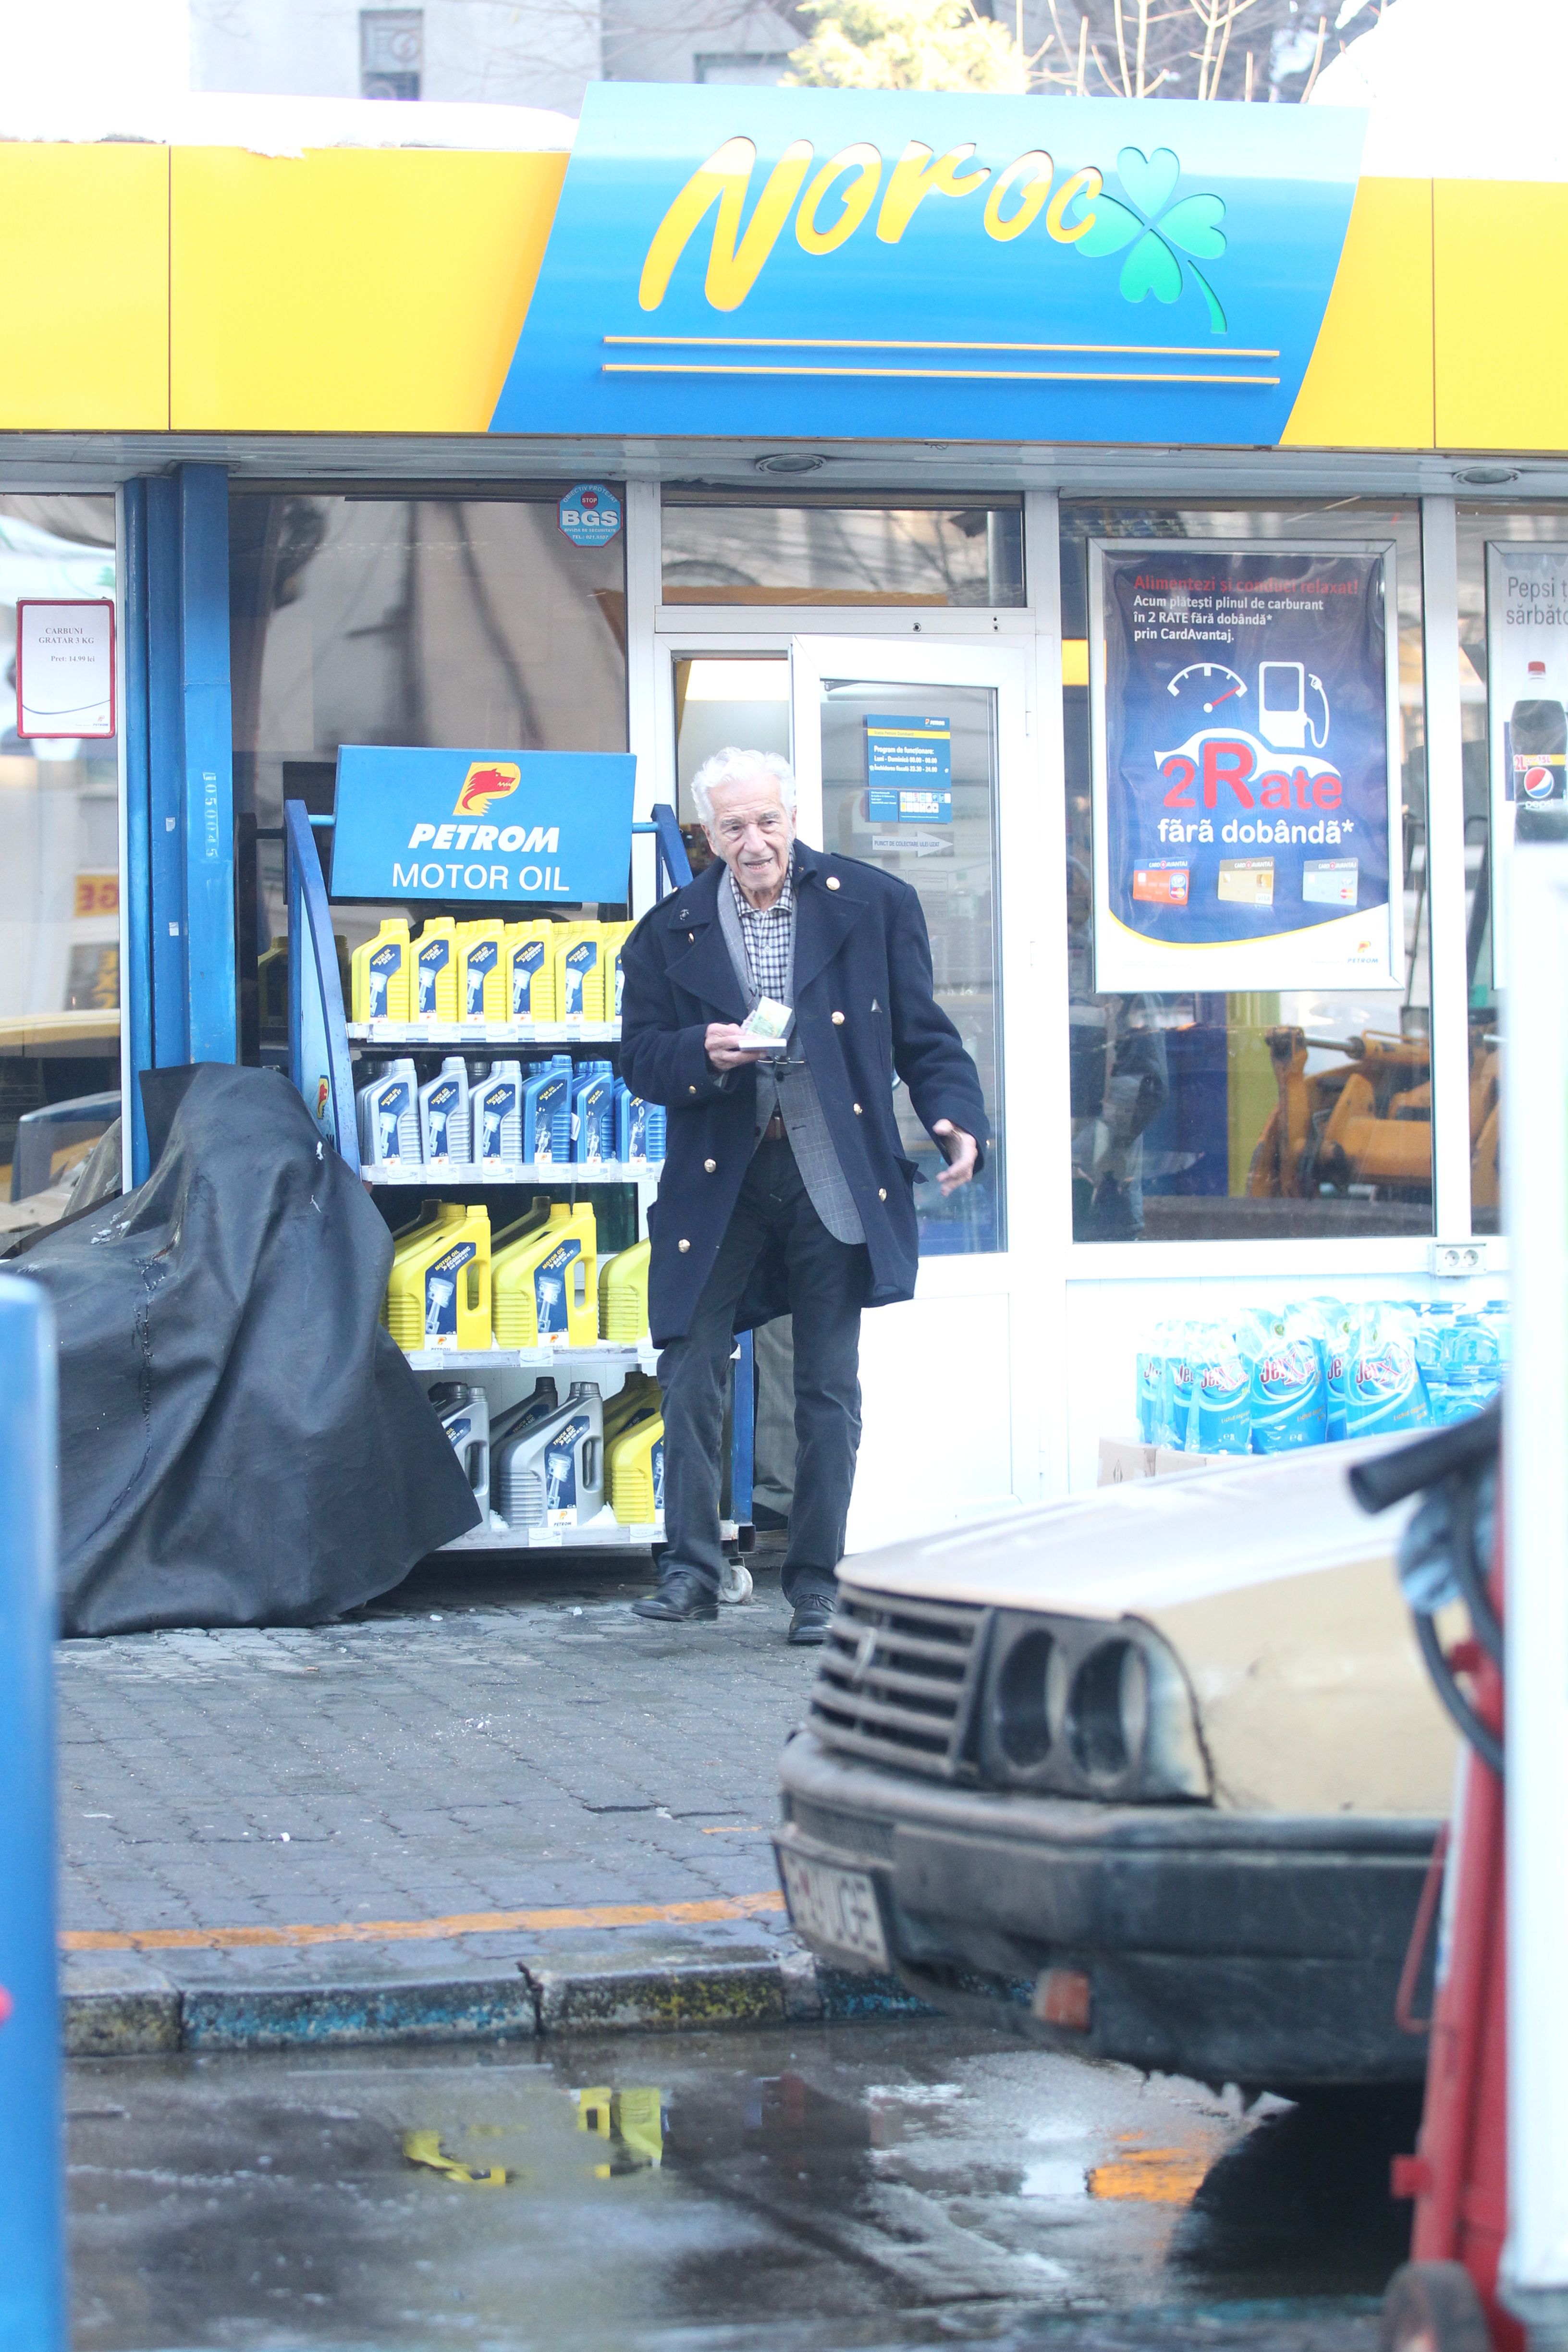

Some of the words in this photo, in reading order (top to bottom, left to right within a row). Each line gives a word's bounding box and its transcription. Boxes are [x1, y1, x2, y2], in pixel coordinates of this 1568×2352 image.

[638, 136, 1103, 312] Noroc
[563, 486, 588, 503] OBIECTIV
[589, 485, 618, 503] PROTEJAT
[562, 510, 619, 527] BGS
[1134, 575, 1215, 591] Alimentezi
[1236, 578, 1296, 593] conduci
[1300, 579, 1359, 594] relaxat!
[1508, 576, 1555, 602] Pepsi
[1133, 595, 1166, 607] Acum
[1215, 597, 1248, 610] plinul
[1250, 598, 1264, 609] de
[1268, 598, 1323, 611] carburant
[1134, 612, 1145, 623] în
[1148, 612, 1156, 623] 2
[1159, 612, 1188, 624] RATE
[1190, 612, 1214, 624] fără
[1134, 628, 1157, 643] prin
[1160, 628, 1234, 643] CardAvantaj.
[874, 745, 896, 754] Program
[407, 823, 560, 853] PETROM
[392, 862, 509, 890] MOTOR
[519, 866, 570, 891] OIL
[372, 954, 385, 966] MOTOR
[380, 953, 391, 963] PLUS
[421, 949, 434, 961] MOTOR
[429, 948, 439, 959] PLUS
[469, 951, 482, 963] MOTOR
[515, 951, 528, 963] MOTOR
[568, 951, 580, 962] MOTOR
[380, 1093, 393, 1106] MOTOR
[430, 1091, 443, 1104] TRUCK
[439, 1090, 451, 1101] BASIC
[486, 1093, 498, 1105] TRUCK
[495, 1092, 506, 1102] BASIC
[539, 1091, 549, 1101] GEAR
[588, 1094, 596, 1104] GEAR
[434, 1255, 452, 1271] MOTOR
[451, 1249, 460, 1258] OIL
[446, 1246, 471, 1268] ECONOMIC
[542, 1253, 558, 1270] MOTOR
[557, 1247, 565, 1255] OIL
[553, 1251, 566, 1265] BASIC
[446, 1427, 454, 1435] OIL
[552, 1431, 567, 1446] TRUCK
[566, 1424, 574, 1433] OIL
[563, 1428, 576, 1442] BASIC
